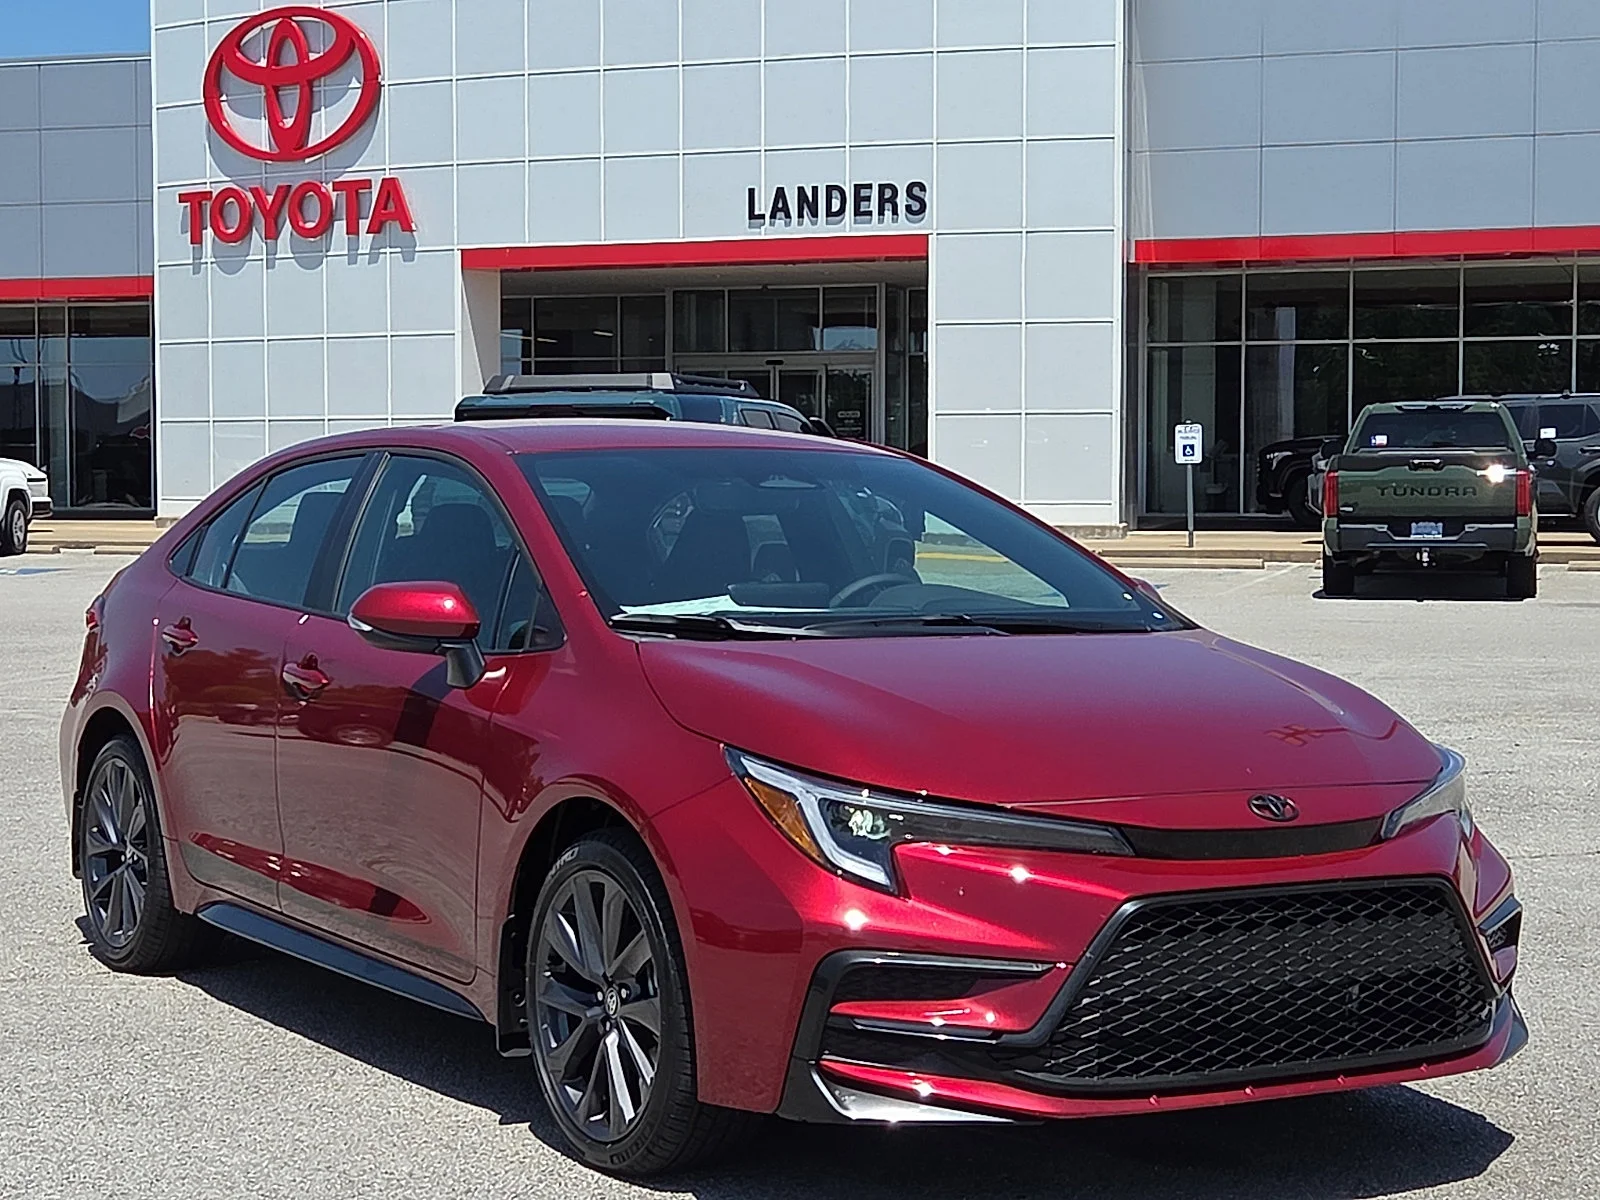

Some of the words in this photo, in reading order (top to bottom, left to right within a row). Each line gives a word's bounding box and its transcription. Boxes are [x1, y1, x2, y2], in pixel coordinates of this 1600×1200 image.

[178, 177, 417, 245] TOYOTA
[748, 181, 927, 220] LANDERS
[1376, 486, 1477, 497] TUNDRA
